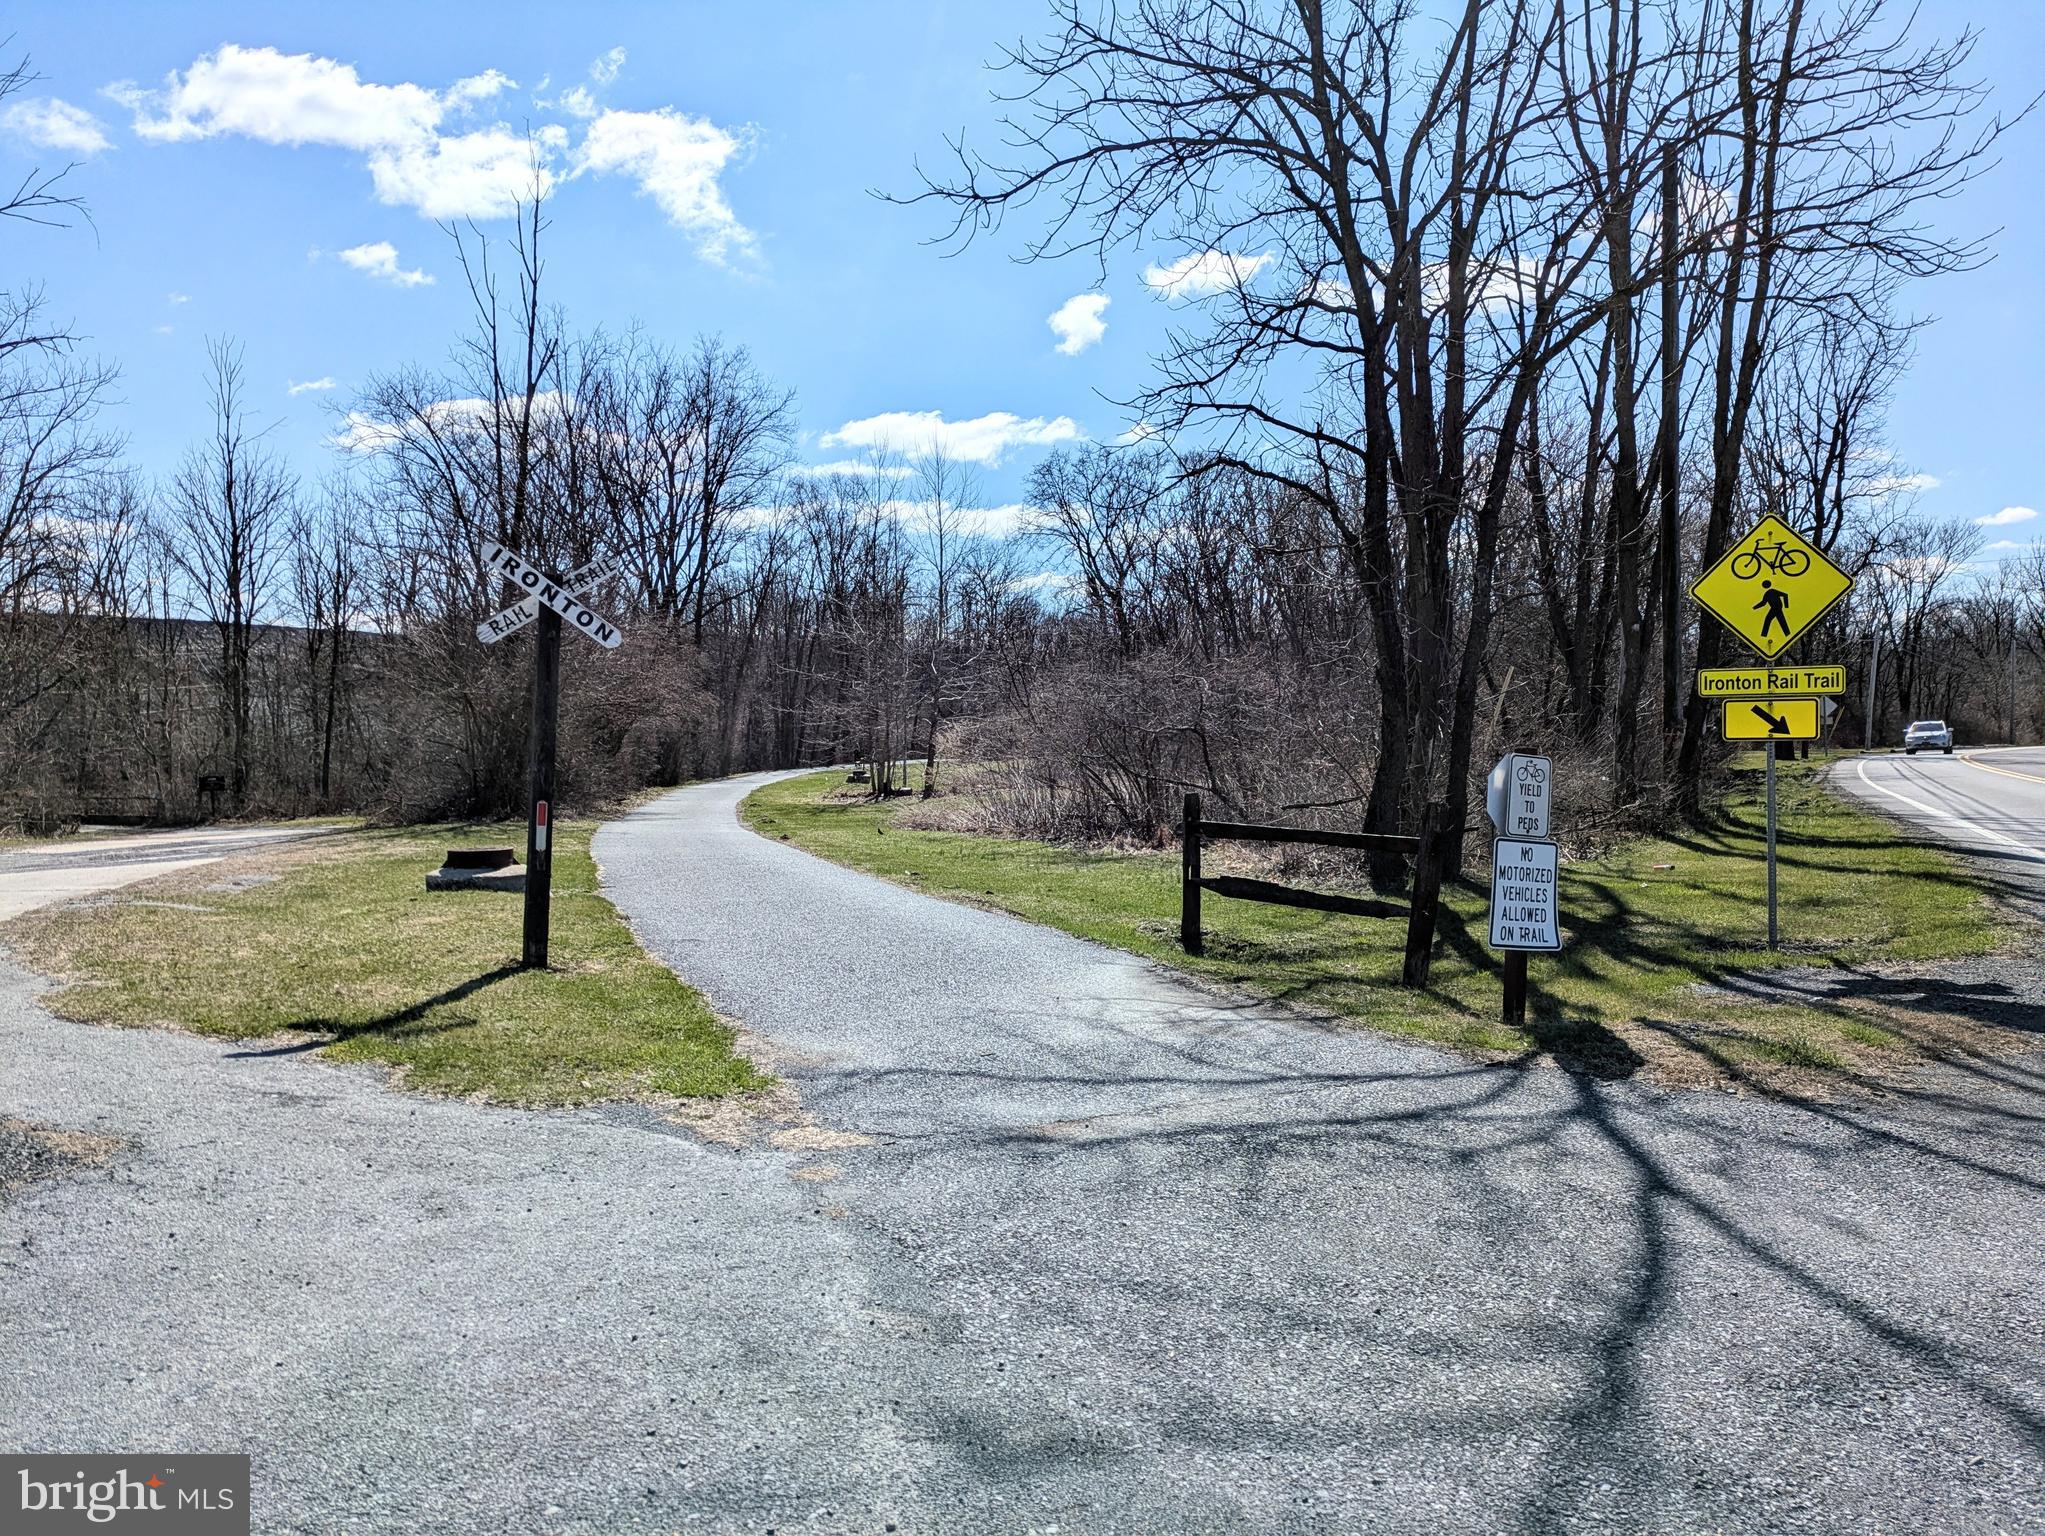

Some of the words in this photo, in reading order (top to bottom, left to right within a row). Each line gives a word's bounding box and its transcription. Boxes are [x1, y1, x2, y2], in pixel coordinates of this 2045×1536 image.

[488, 605, 533, 636] RAIL
[565, 558, 617, 593] TRAIL
[490, 549, 614, 642] IRONTON
[1703, 674, 1762, 691] Ironton
[1767, 673, 1799, 690] Rail
[1804, 671, 1840, 689] Trail
[1519, 782, 1542, 798] YIELD
[1524, 800, 1535, 813] TO
[1517, 816, 1539, 831] PEDS
[1520, 846, 1534, 862] NO
[1499, 865, 1553, 884] MOTORIZED
[1502, 885, 1548, 904] VEHICLES
[1501, 905, 1547, 923] ALLOWED
[1500, 925, 1514, 942] ON
[1519, 926, 1549, 943] TRAIL
